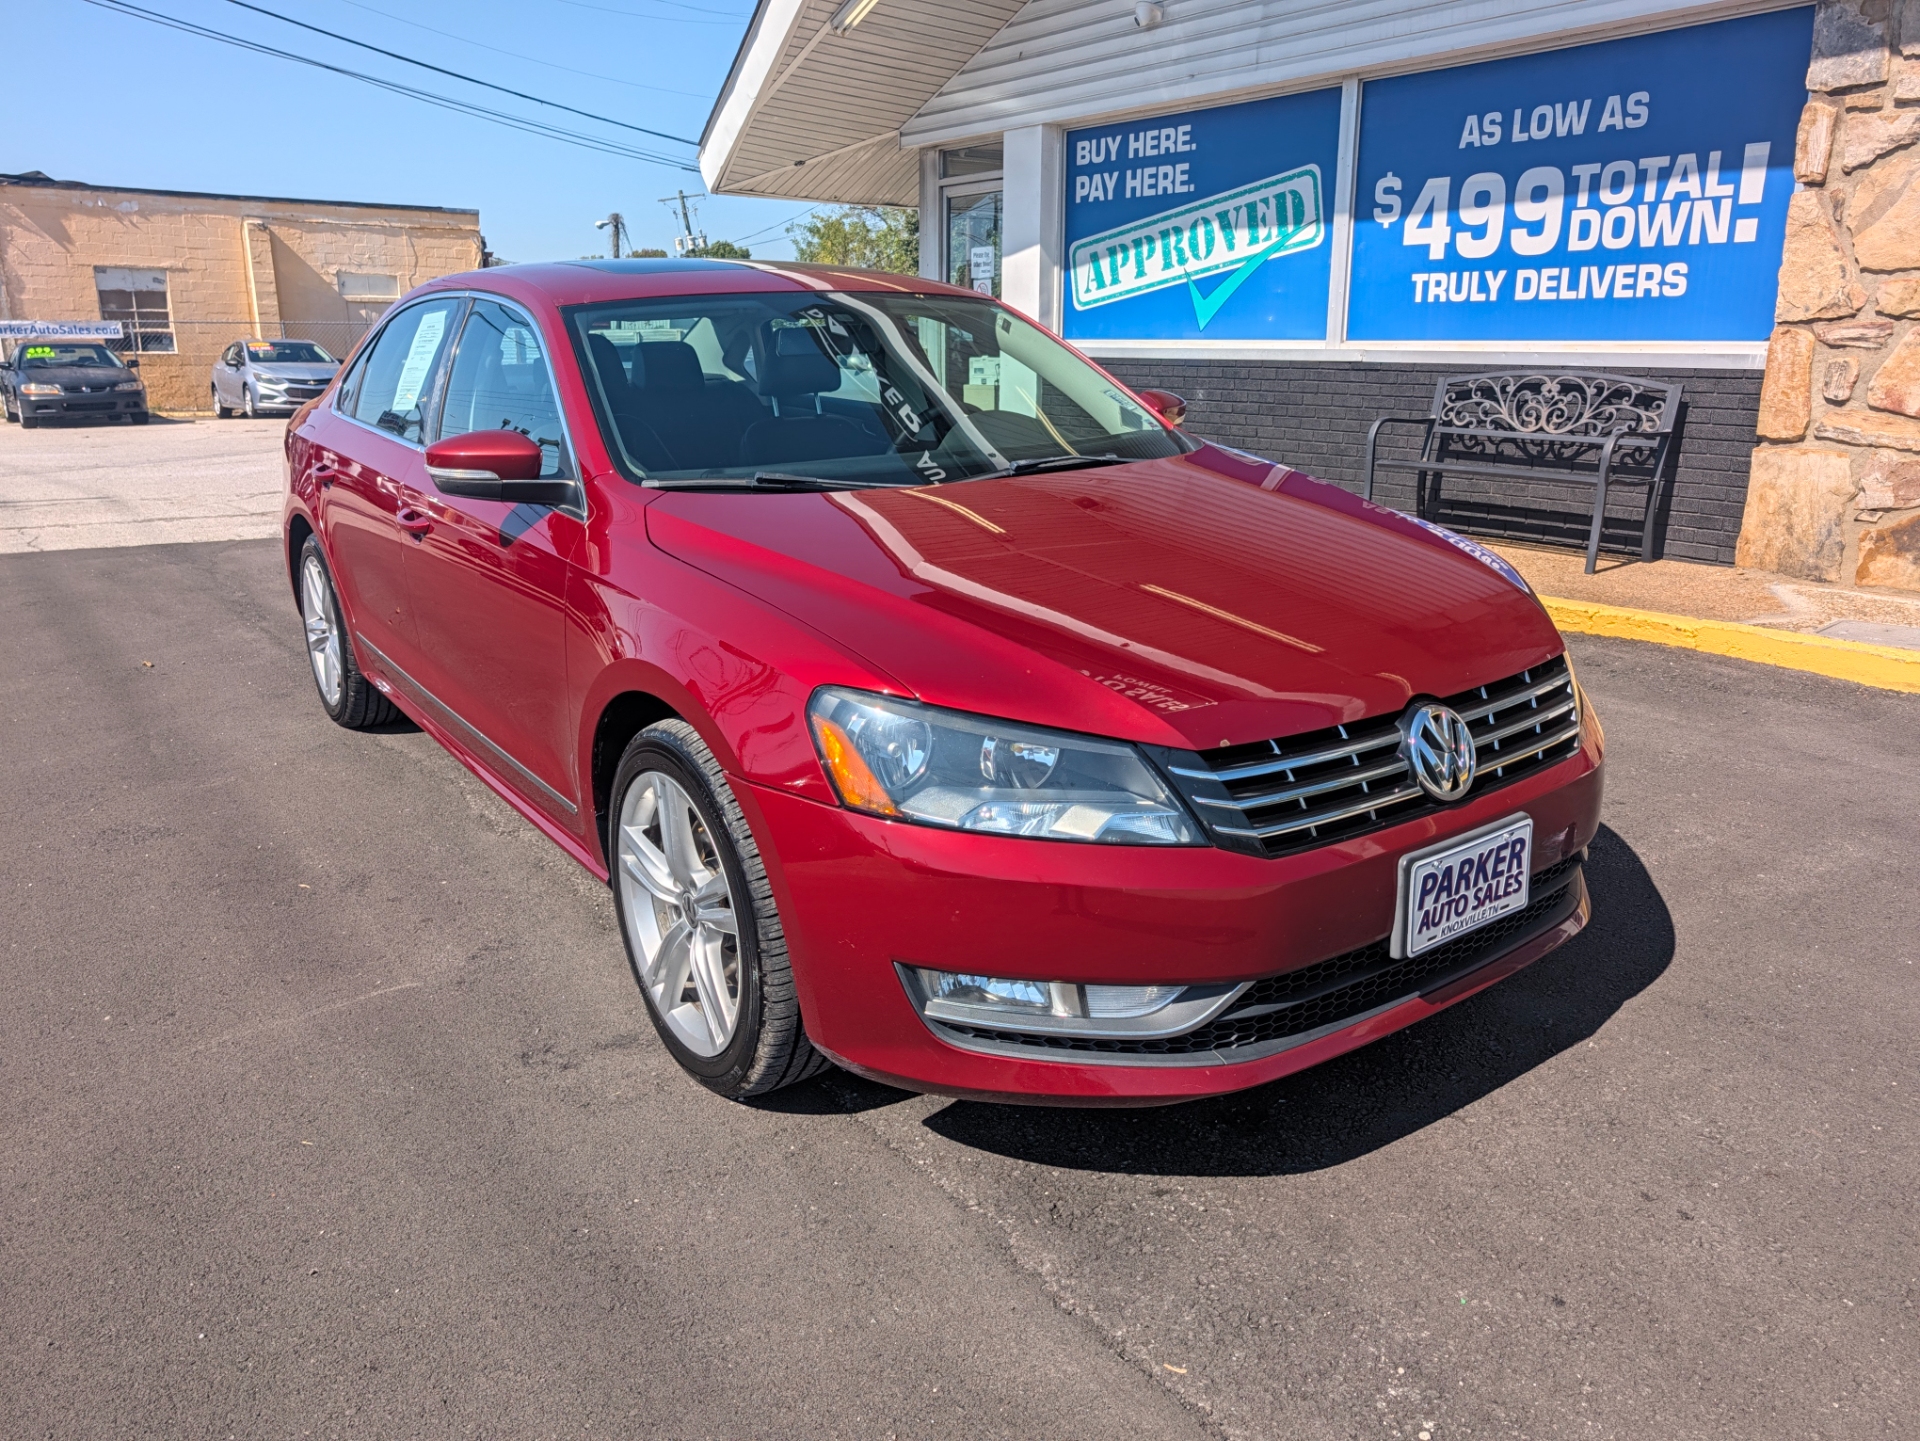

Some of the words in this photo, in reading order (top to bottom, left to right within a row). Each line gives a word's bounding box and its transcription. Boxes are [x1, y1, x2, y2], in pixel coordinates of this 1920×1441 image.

[1075, 135, 1122, 166] BUY
[1128, 124, 1197, 158] HERE.
[1458, 112, 1502, 149] AS
[1511, 98, 1592, 143] LOW
[1598, 91, 1650, 133] AS
[1075, 171, 1119, 204] PAY
[1125, 162, 1195, 199] HERE.
[1571, 150, 1735, 207] TOTAL
[1083, 188, 1306, 295] APPROVED
[1411, 269, 1507, 303] TRULY
[1514, 262, 1688, 301] DELIVERS
[1417, 836, 1526, 911] PARKER
[1416, 893, 1469, 935] AUTO
[1471, 870, 1524, 911] SALES
